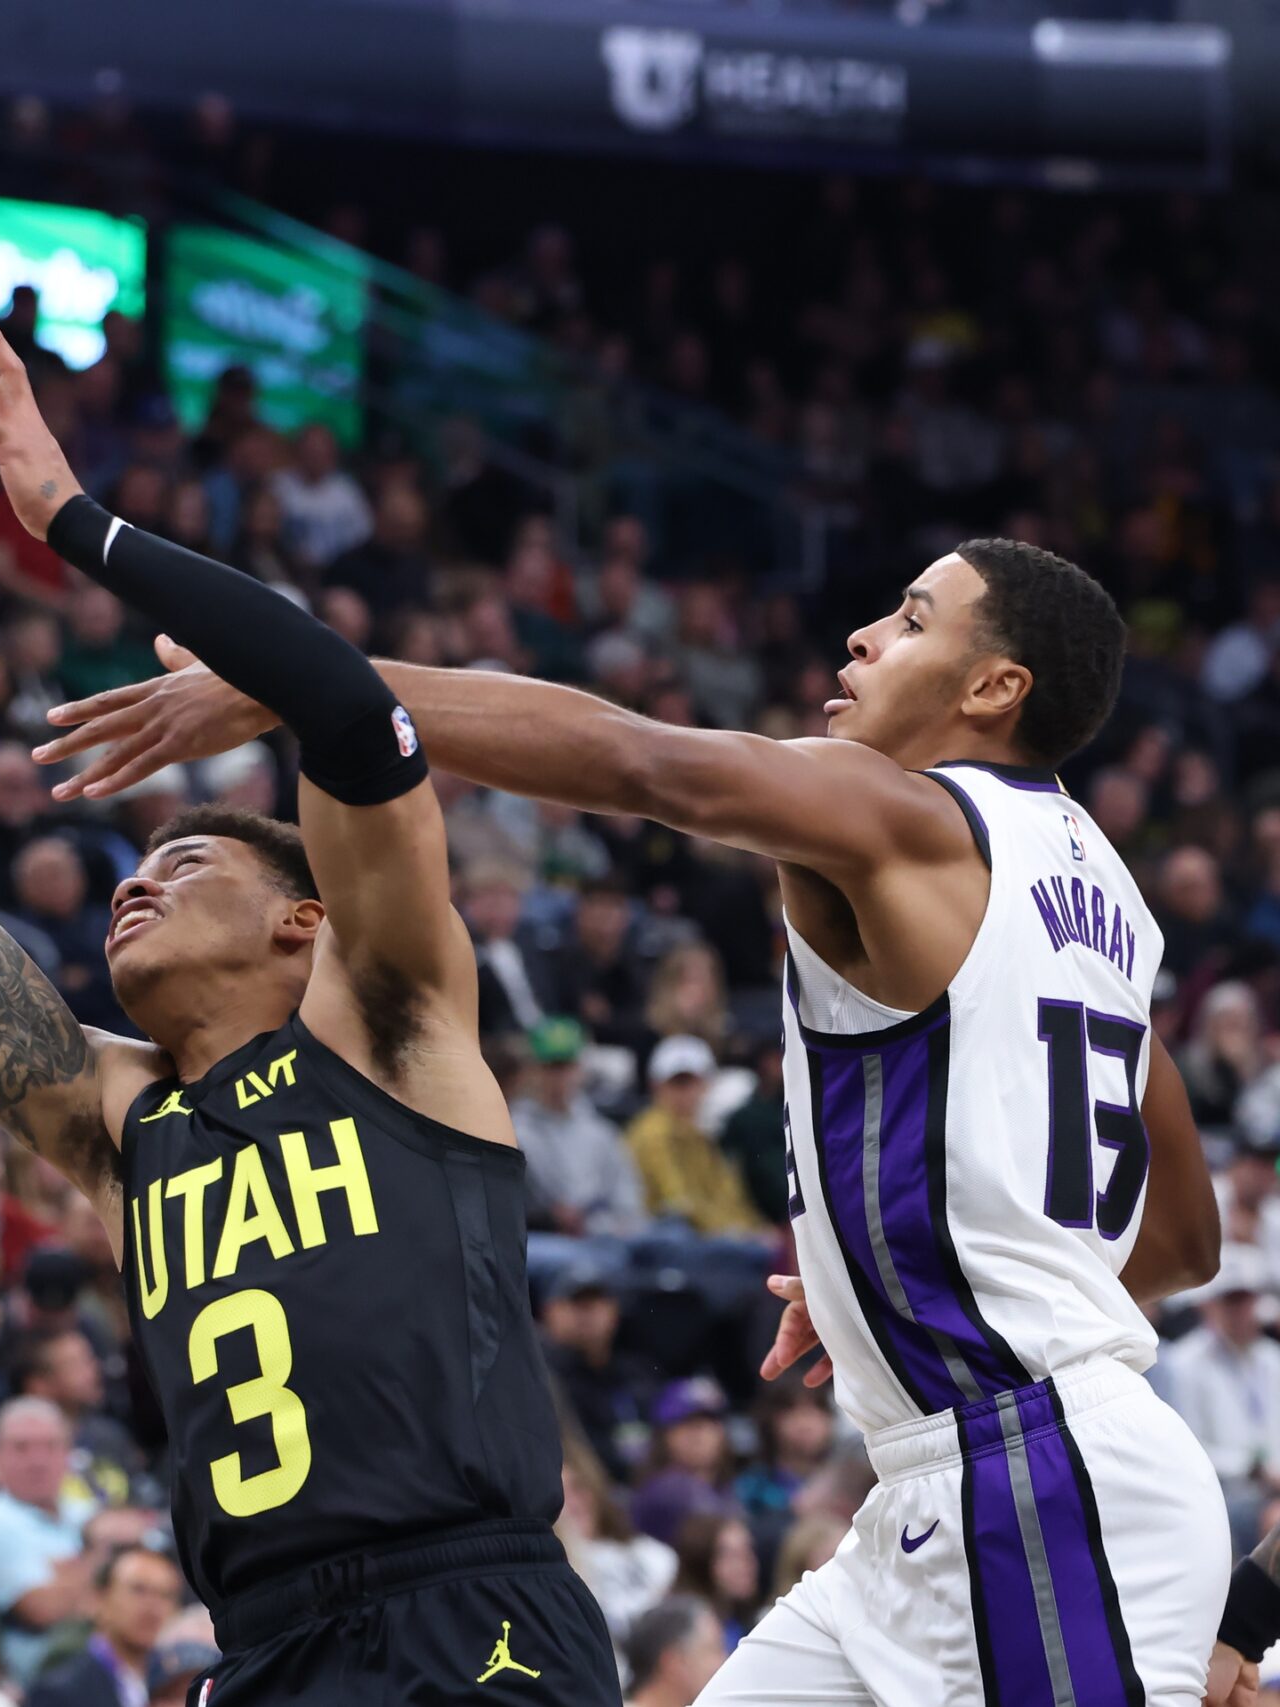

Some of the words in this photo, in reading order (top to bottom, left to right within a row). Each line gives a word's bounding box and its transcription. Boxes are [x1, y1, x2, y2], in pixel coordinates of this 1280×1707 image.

[705, 50, 908, 117] HEALTH
[1030, 875, 1135, 982] MURRAY
[235, 1049, 297, 1109] LVT
[1037, 996, 1152, 1241] 13
[132, 1117, 379, 1320] UTAH
[188, 1288, 312, 1517] 3
